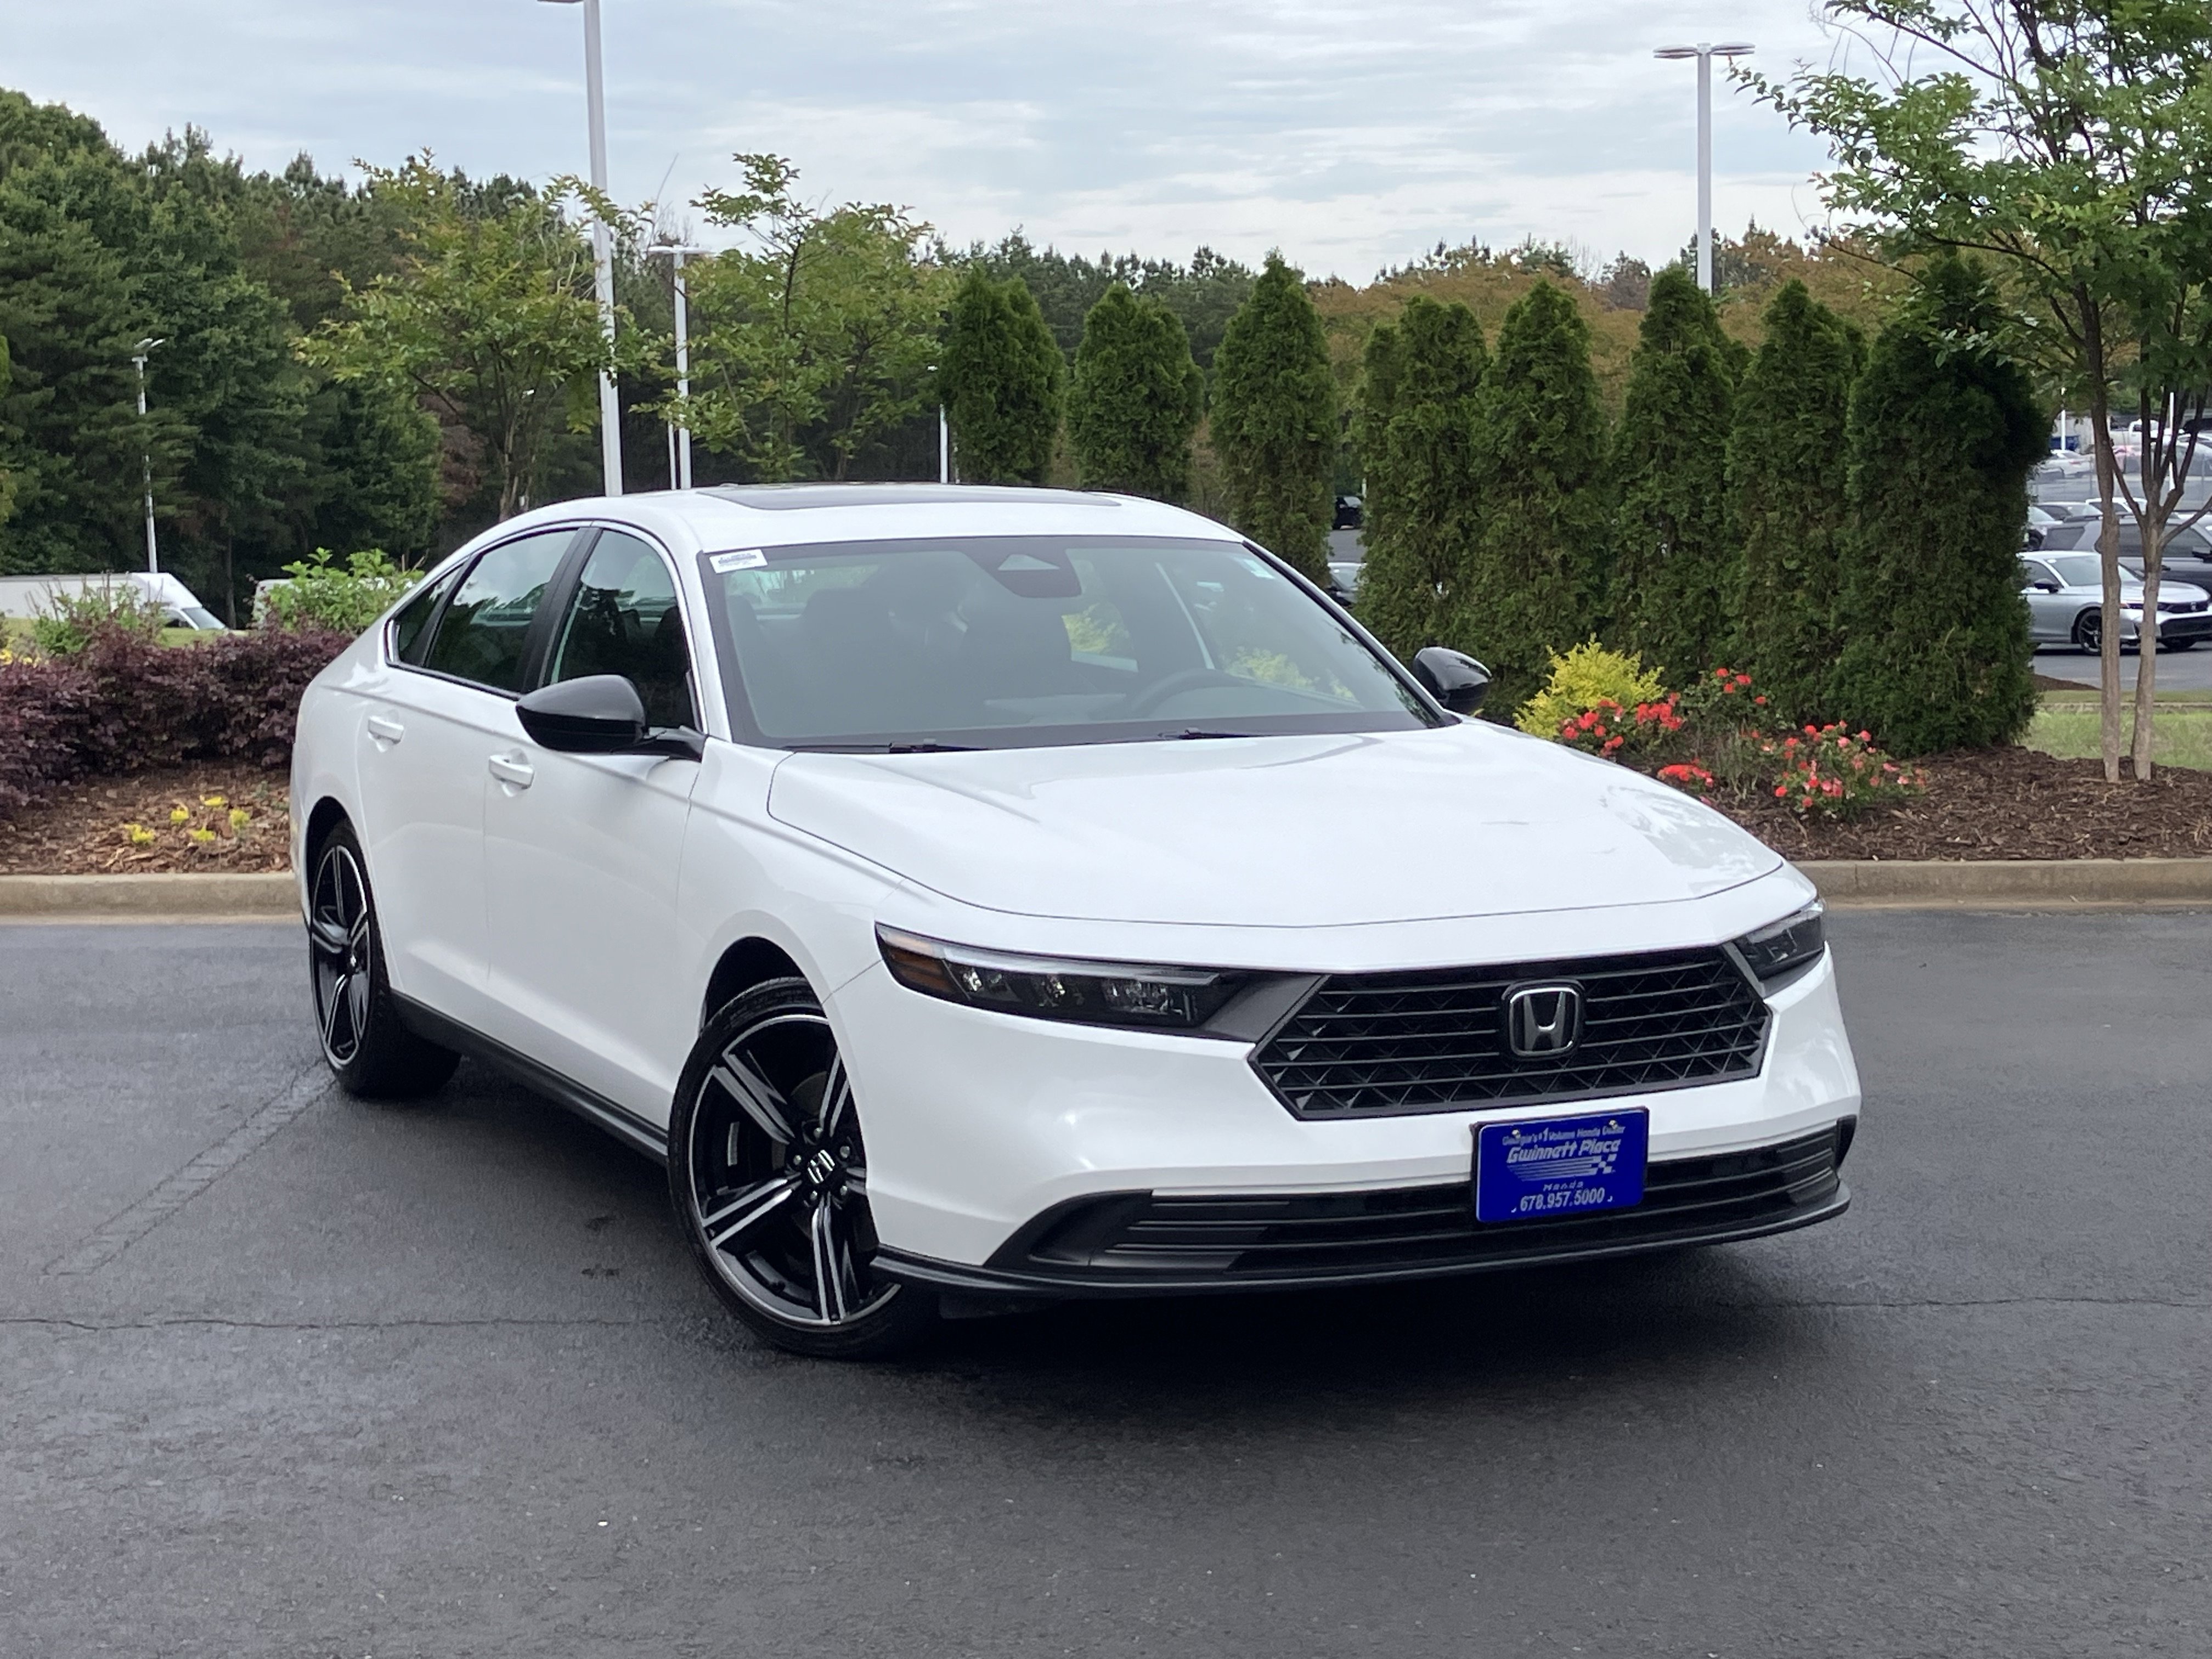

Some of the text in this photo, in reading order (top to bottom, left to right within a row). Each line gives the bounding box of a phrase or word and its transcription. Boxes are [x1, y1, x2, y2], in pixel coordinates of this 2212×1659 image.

[1577, 1127, 1601, 1138] Honda
[1506, 1137, 1622, 1164] Gwinnett Place
[1543, 1180, 1584, 1192] Honda
[1520, 1187, 1606, 1212] 678.957.5000
